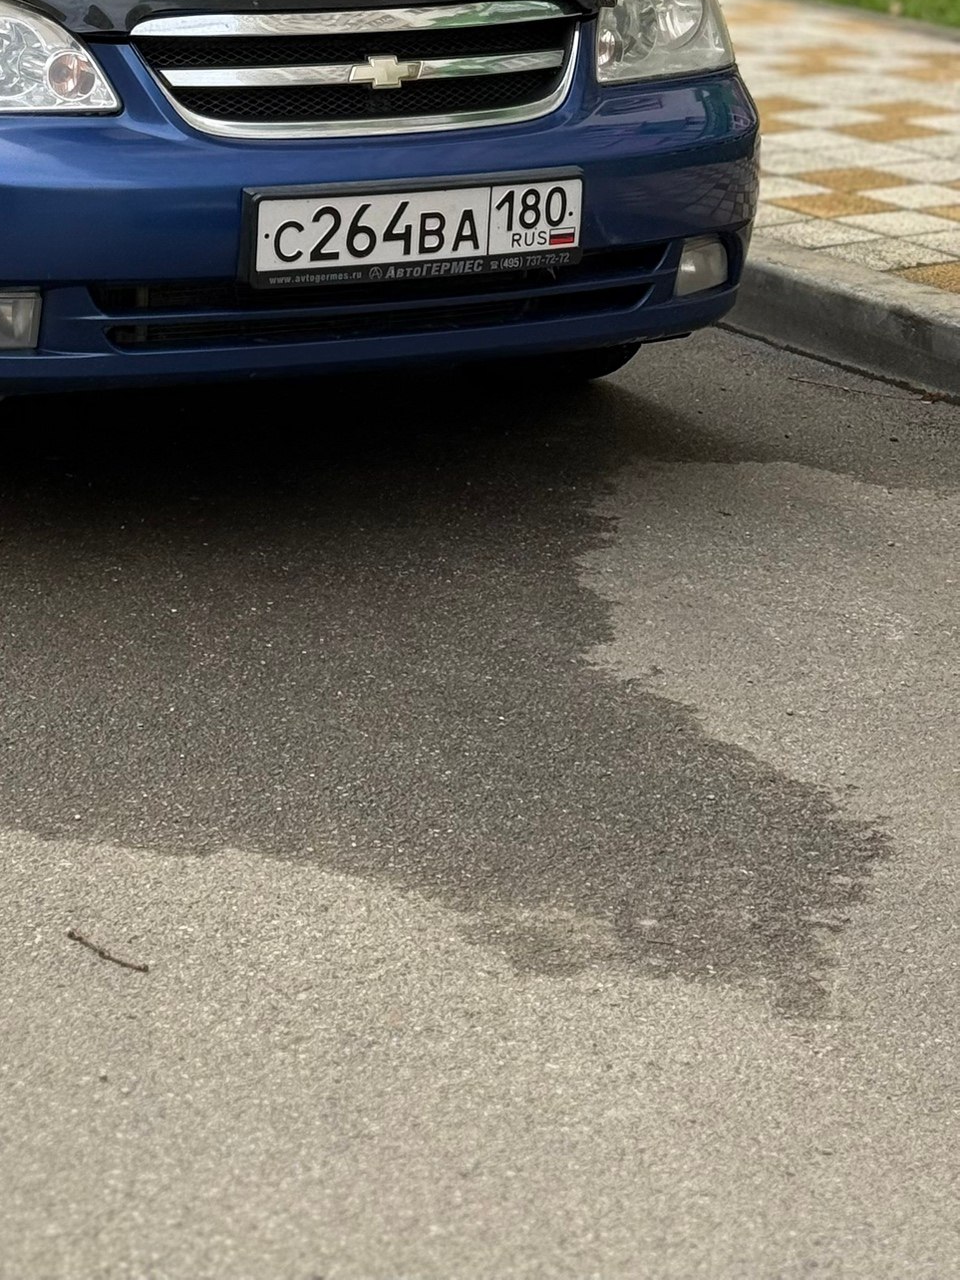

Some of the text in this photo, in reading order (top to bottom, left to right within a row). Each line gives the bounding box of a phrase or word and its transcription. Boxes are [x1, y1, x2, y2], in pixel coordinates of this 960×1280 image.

[495, 186, 567, 232] 180
[274, 200, 480, 262] С264ВА
[511, 230, 548, 248] RUS
[499, 252, 570, 270] (495) 737-72-72
[269, 271, 362, 285] www.avtogermes.ru
